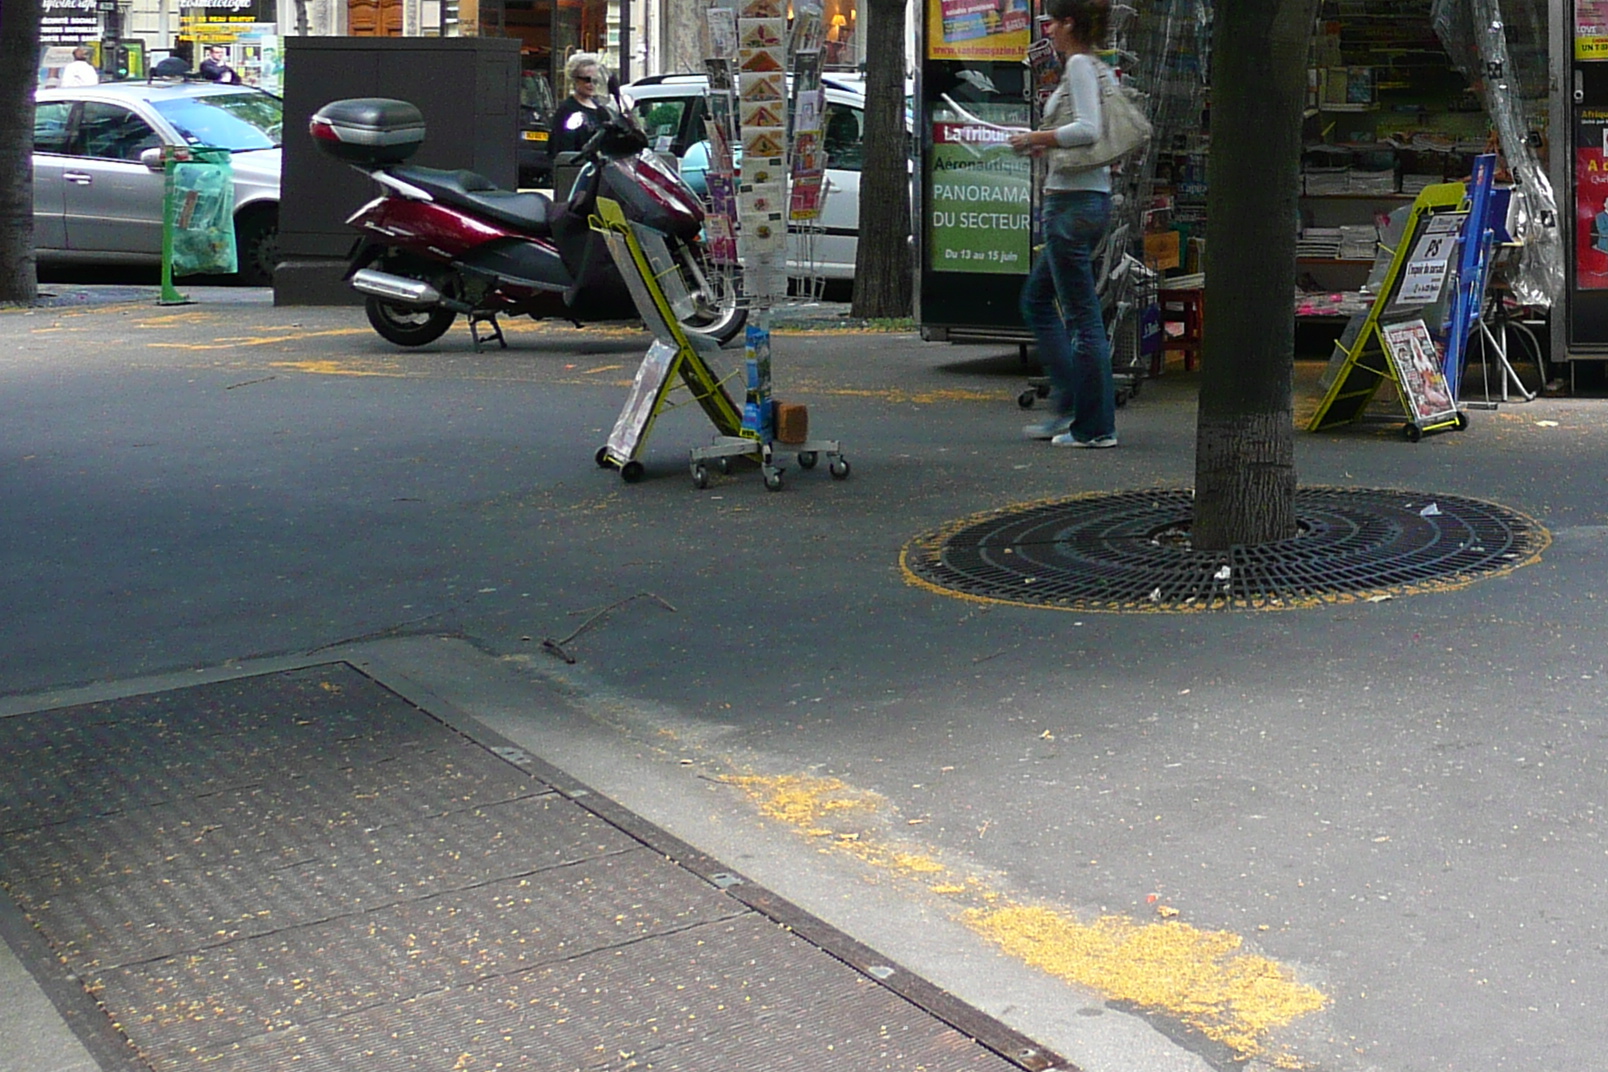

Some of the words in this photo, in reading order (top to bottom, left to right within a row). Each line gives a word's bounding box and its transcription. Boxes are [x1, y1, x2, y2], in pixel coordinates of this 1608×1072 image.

[943, 125, 961, 141] La
[963, 124, 1012, 142] Tribun
[934, 156, 1030, 175] Aéronautique
[1588, 159, 1598, 171] A
[933, 184, 1031, 203] PANORAMA
[933, 211, 955, 227] DU
[959, 212, 1030, 230] SECTEUR
[945, 249, 958, 259] Du
[961, 249, 971, 259] 13
[972, 251, 985, 260] au
[988, 250, 999, 261] 15
[1000, 250, 1018, 263] juin
[1424, 238, 1442, 257] PS
